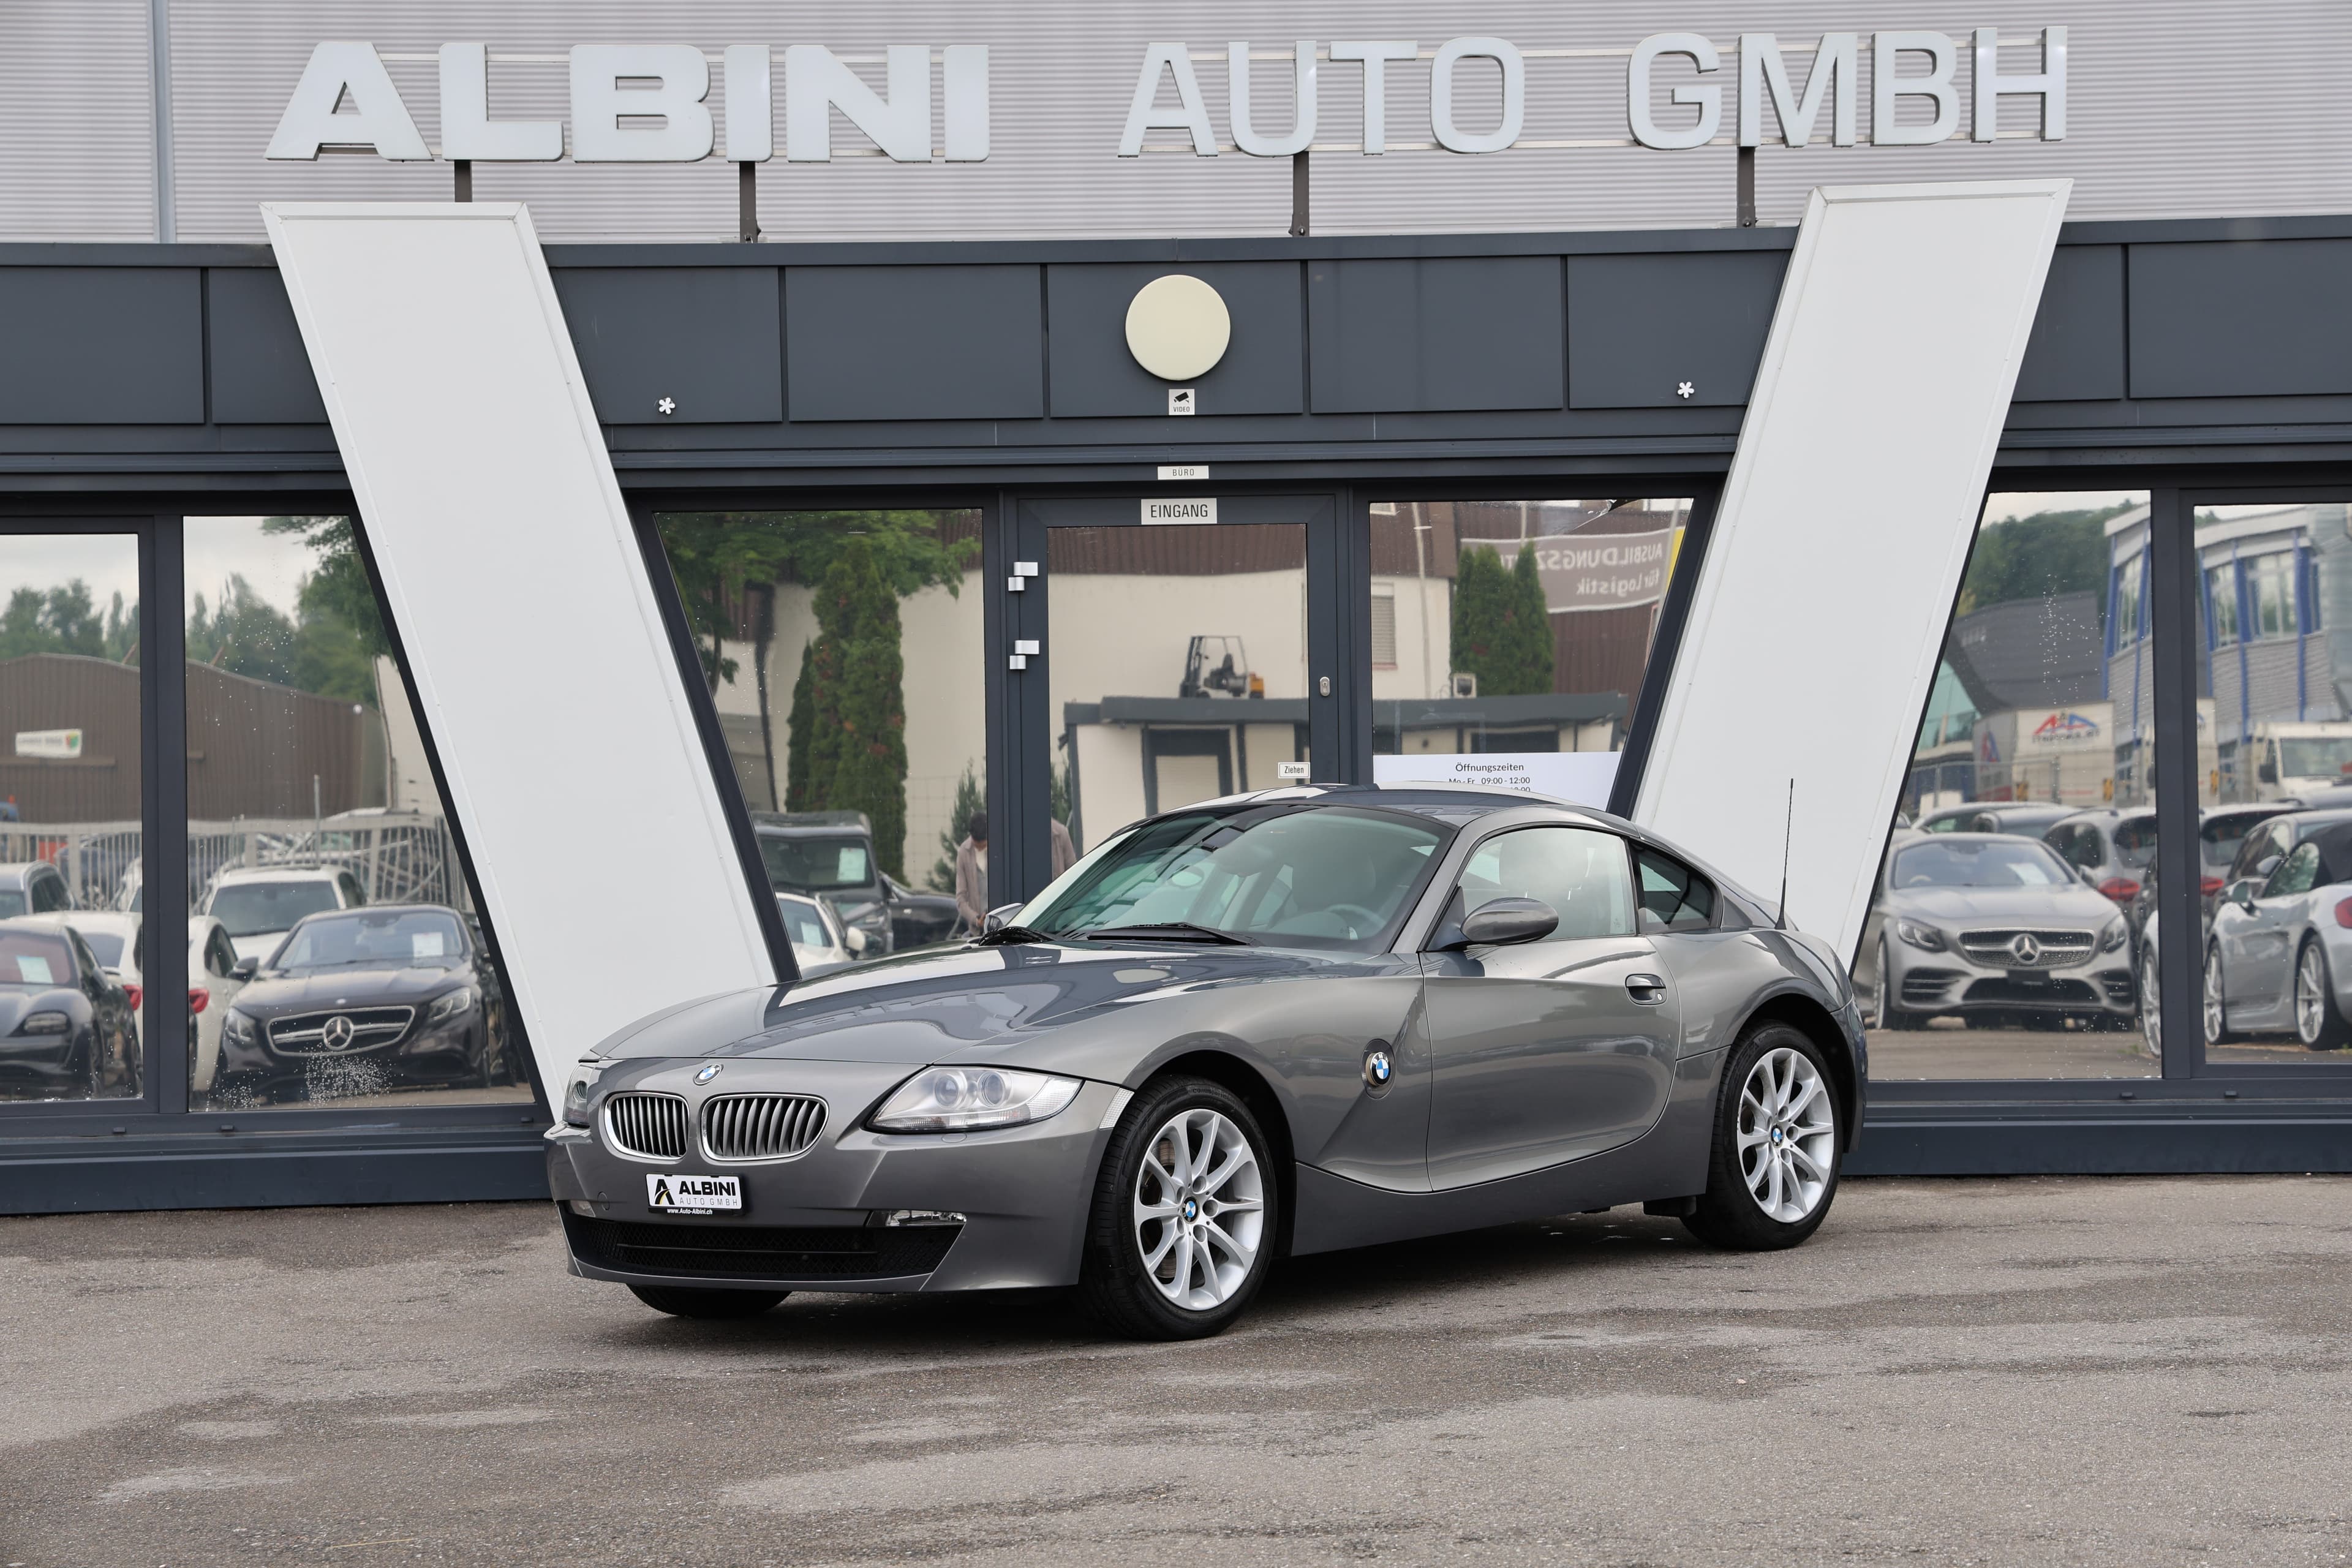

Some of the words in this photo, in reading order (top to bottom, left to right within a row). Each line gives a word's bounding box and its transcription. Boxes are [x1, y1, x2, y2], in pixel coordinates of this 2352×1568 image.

[264, 40, 990, 164] ALBINI
[1118, 36, 1525, 159] AUTO
[1626, 25, 2068, 151] GMBH
[1172, 467, 1194, 477] BÜRO
[1150, 504, 1208, 518] EINGANG
[1455, 762, 1524, 773] Öffnungszeiten
[679, 1181, 736, 1196] ALBINI
